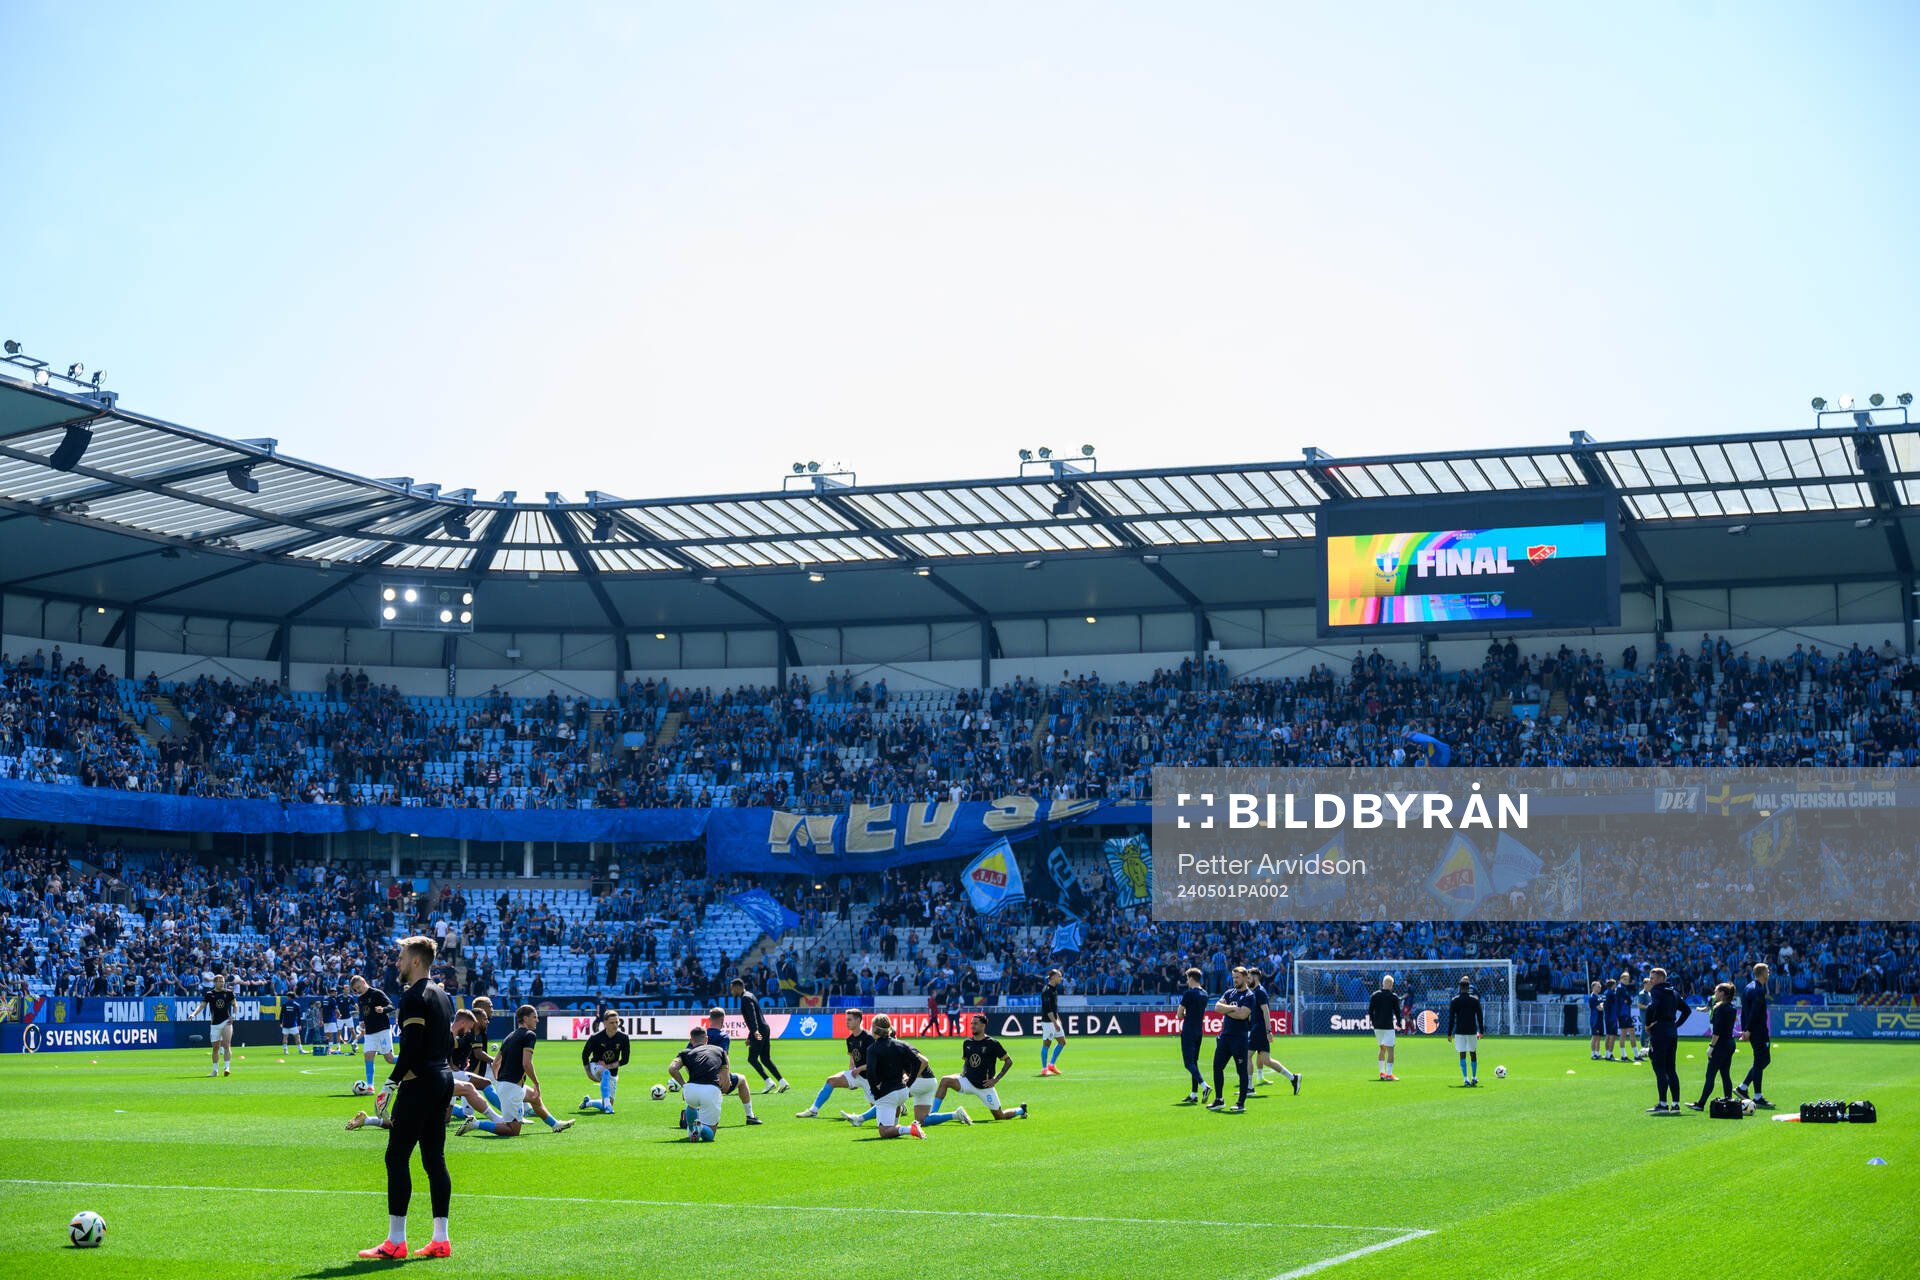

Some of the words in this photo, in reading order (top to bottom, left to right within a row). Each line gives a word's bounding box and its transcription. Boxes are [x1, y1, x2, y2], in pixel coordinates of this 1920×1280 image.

[1417, 546, 1515, 578] FINAL
[1752, 794, 1779, 810] NAL
[1781, 792, 1847, 809] SVENSKA
[1849, 791, 1897, 808] CUPEN
[1033, 1015, 1122, 1034] EEDA
[1784, 1012, 1849, 1028] FAST
[1877, 1012, 1920, 1029] FAS
[46, 1029, 110, 1046] SVENSKA
[113, 1028, 158, 1045] CUPEN
